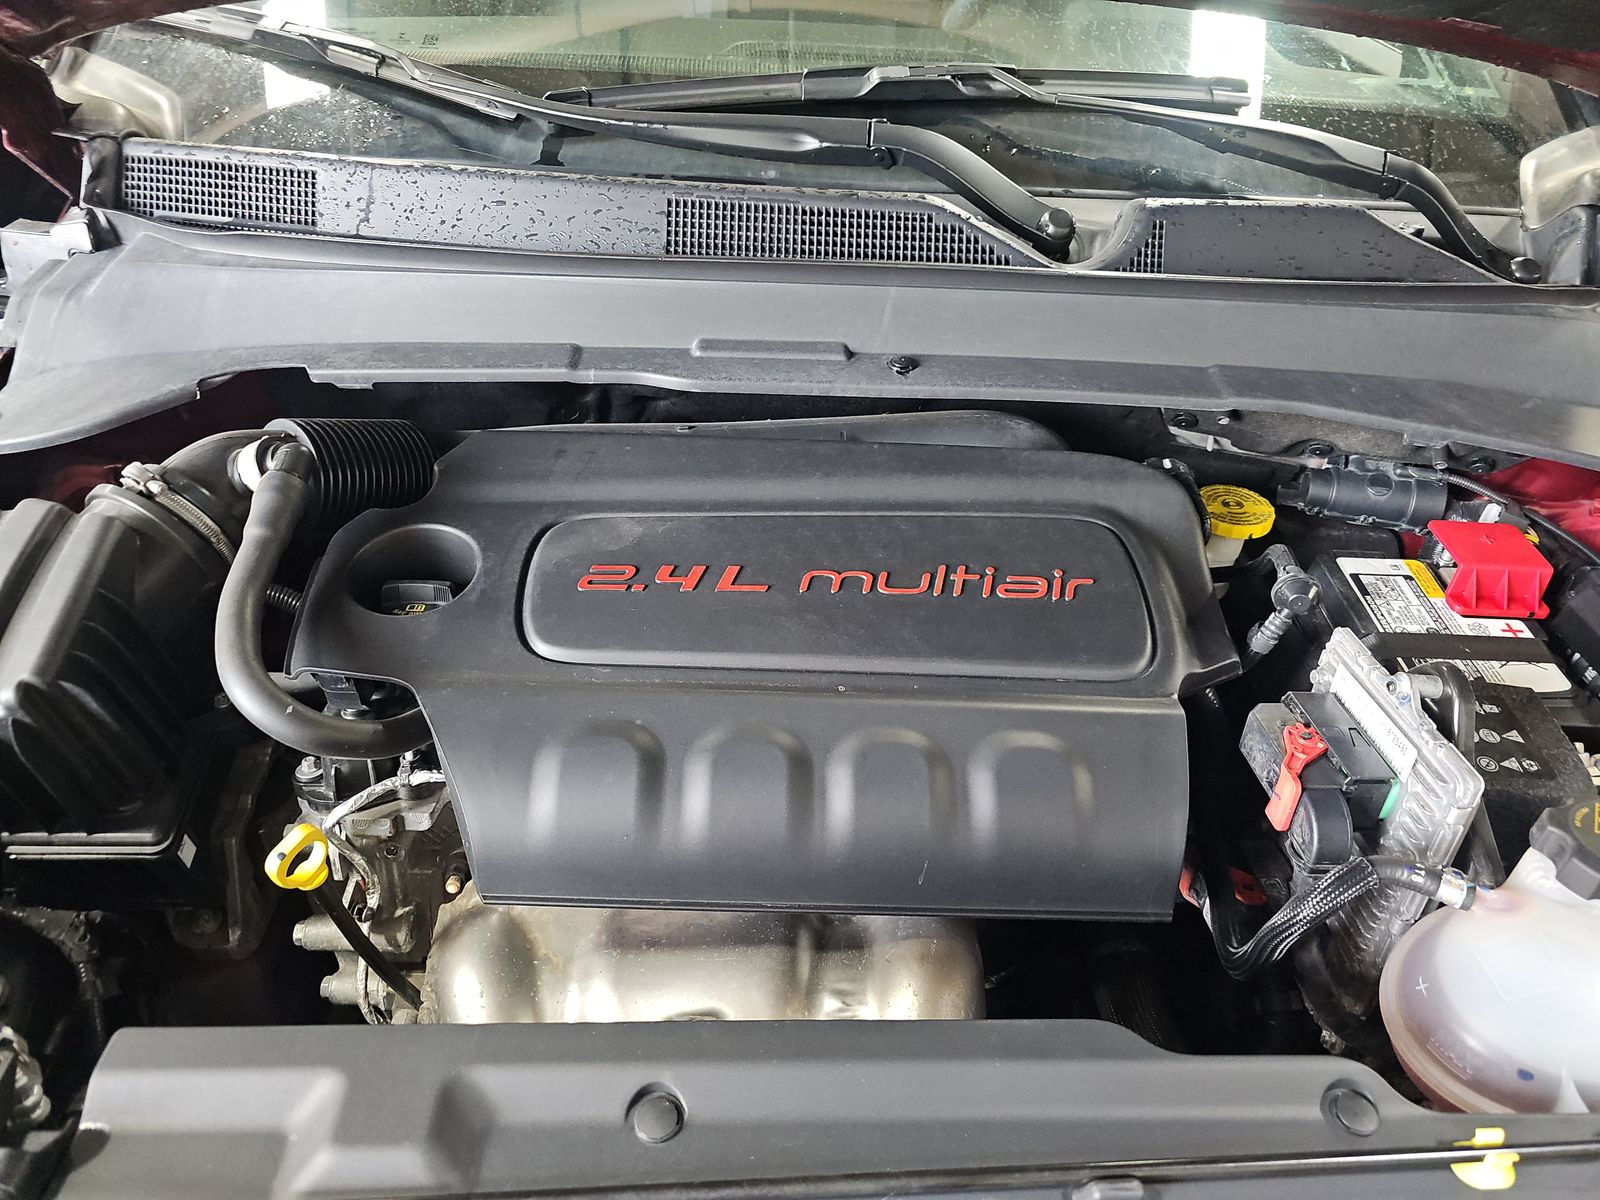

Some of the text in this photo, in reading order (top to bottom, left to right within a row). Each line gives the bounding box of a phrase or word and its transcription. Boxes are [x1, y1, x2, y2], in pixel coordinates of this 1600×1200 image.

[577, 564, 1095, 602] 2.4 L multiair
